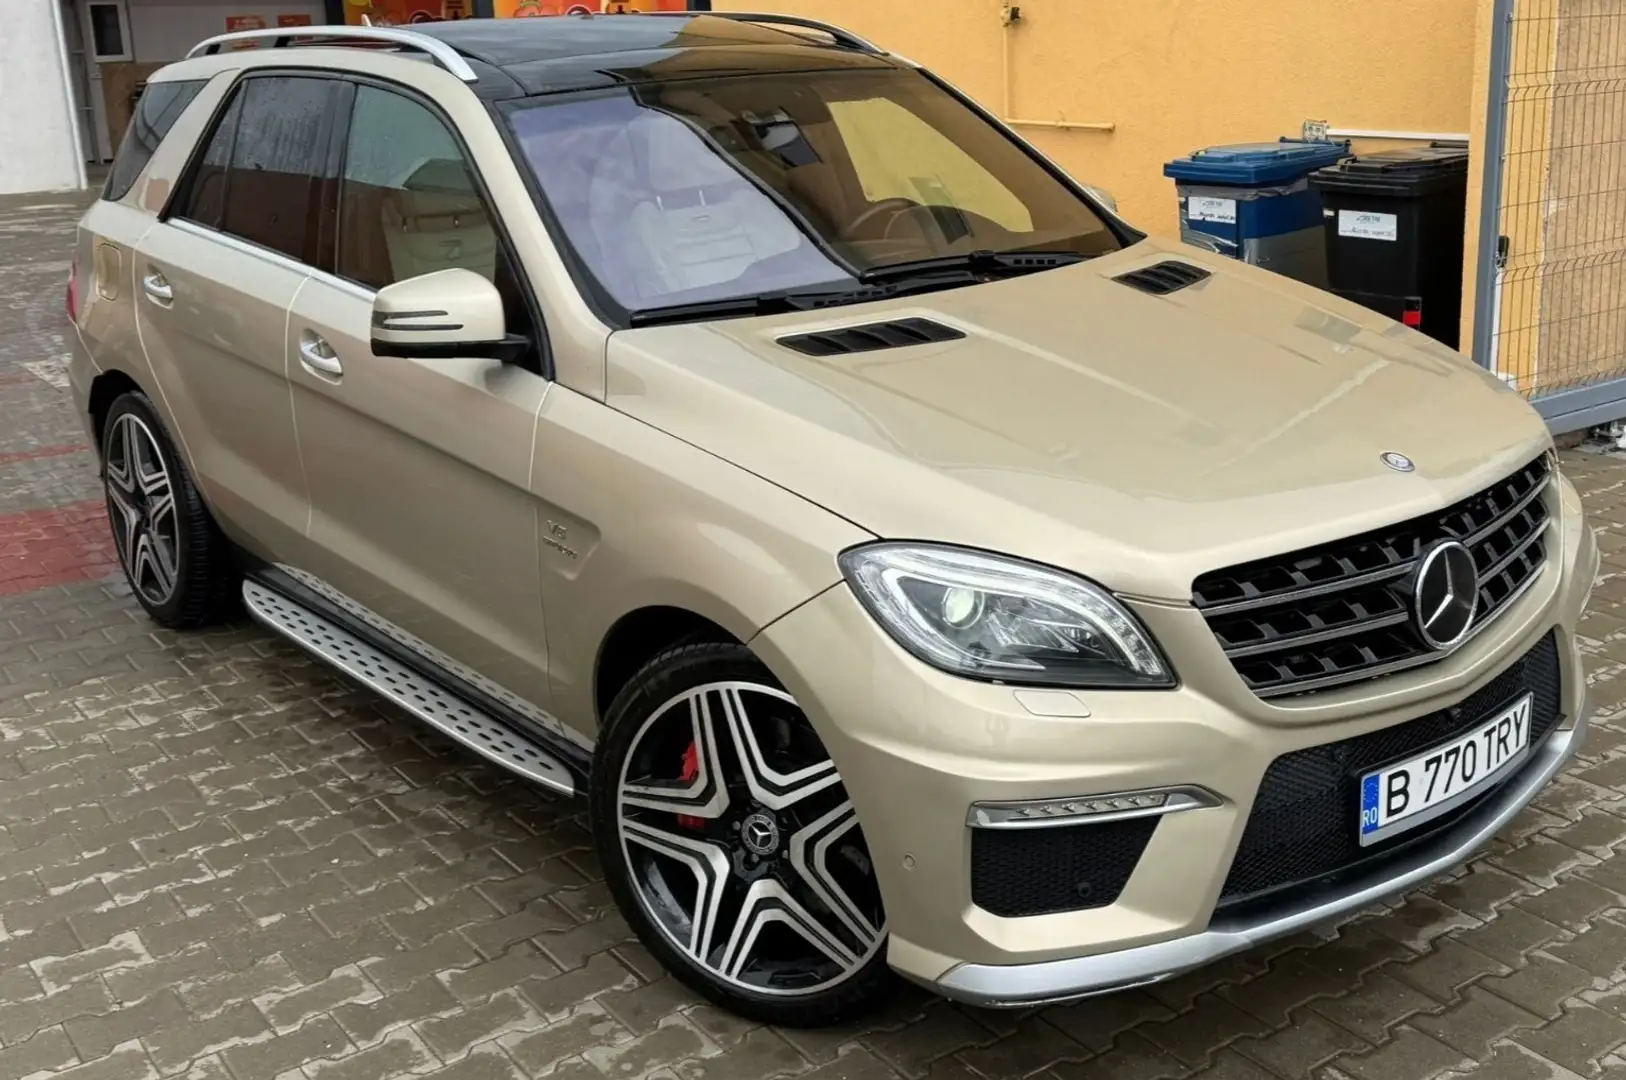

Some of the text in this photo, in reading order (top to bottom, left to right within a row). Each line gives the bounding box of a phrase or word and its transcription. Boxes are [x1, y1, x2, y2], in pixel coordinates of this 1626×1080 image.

[1386, 704, 1527, 818] B 770 TRY
[1362, 806, 1378, 826] RO
